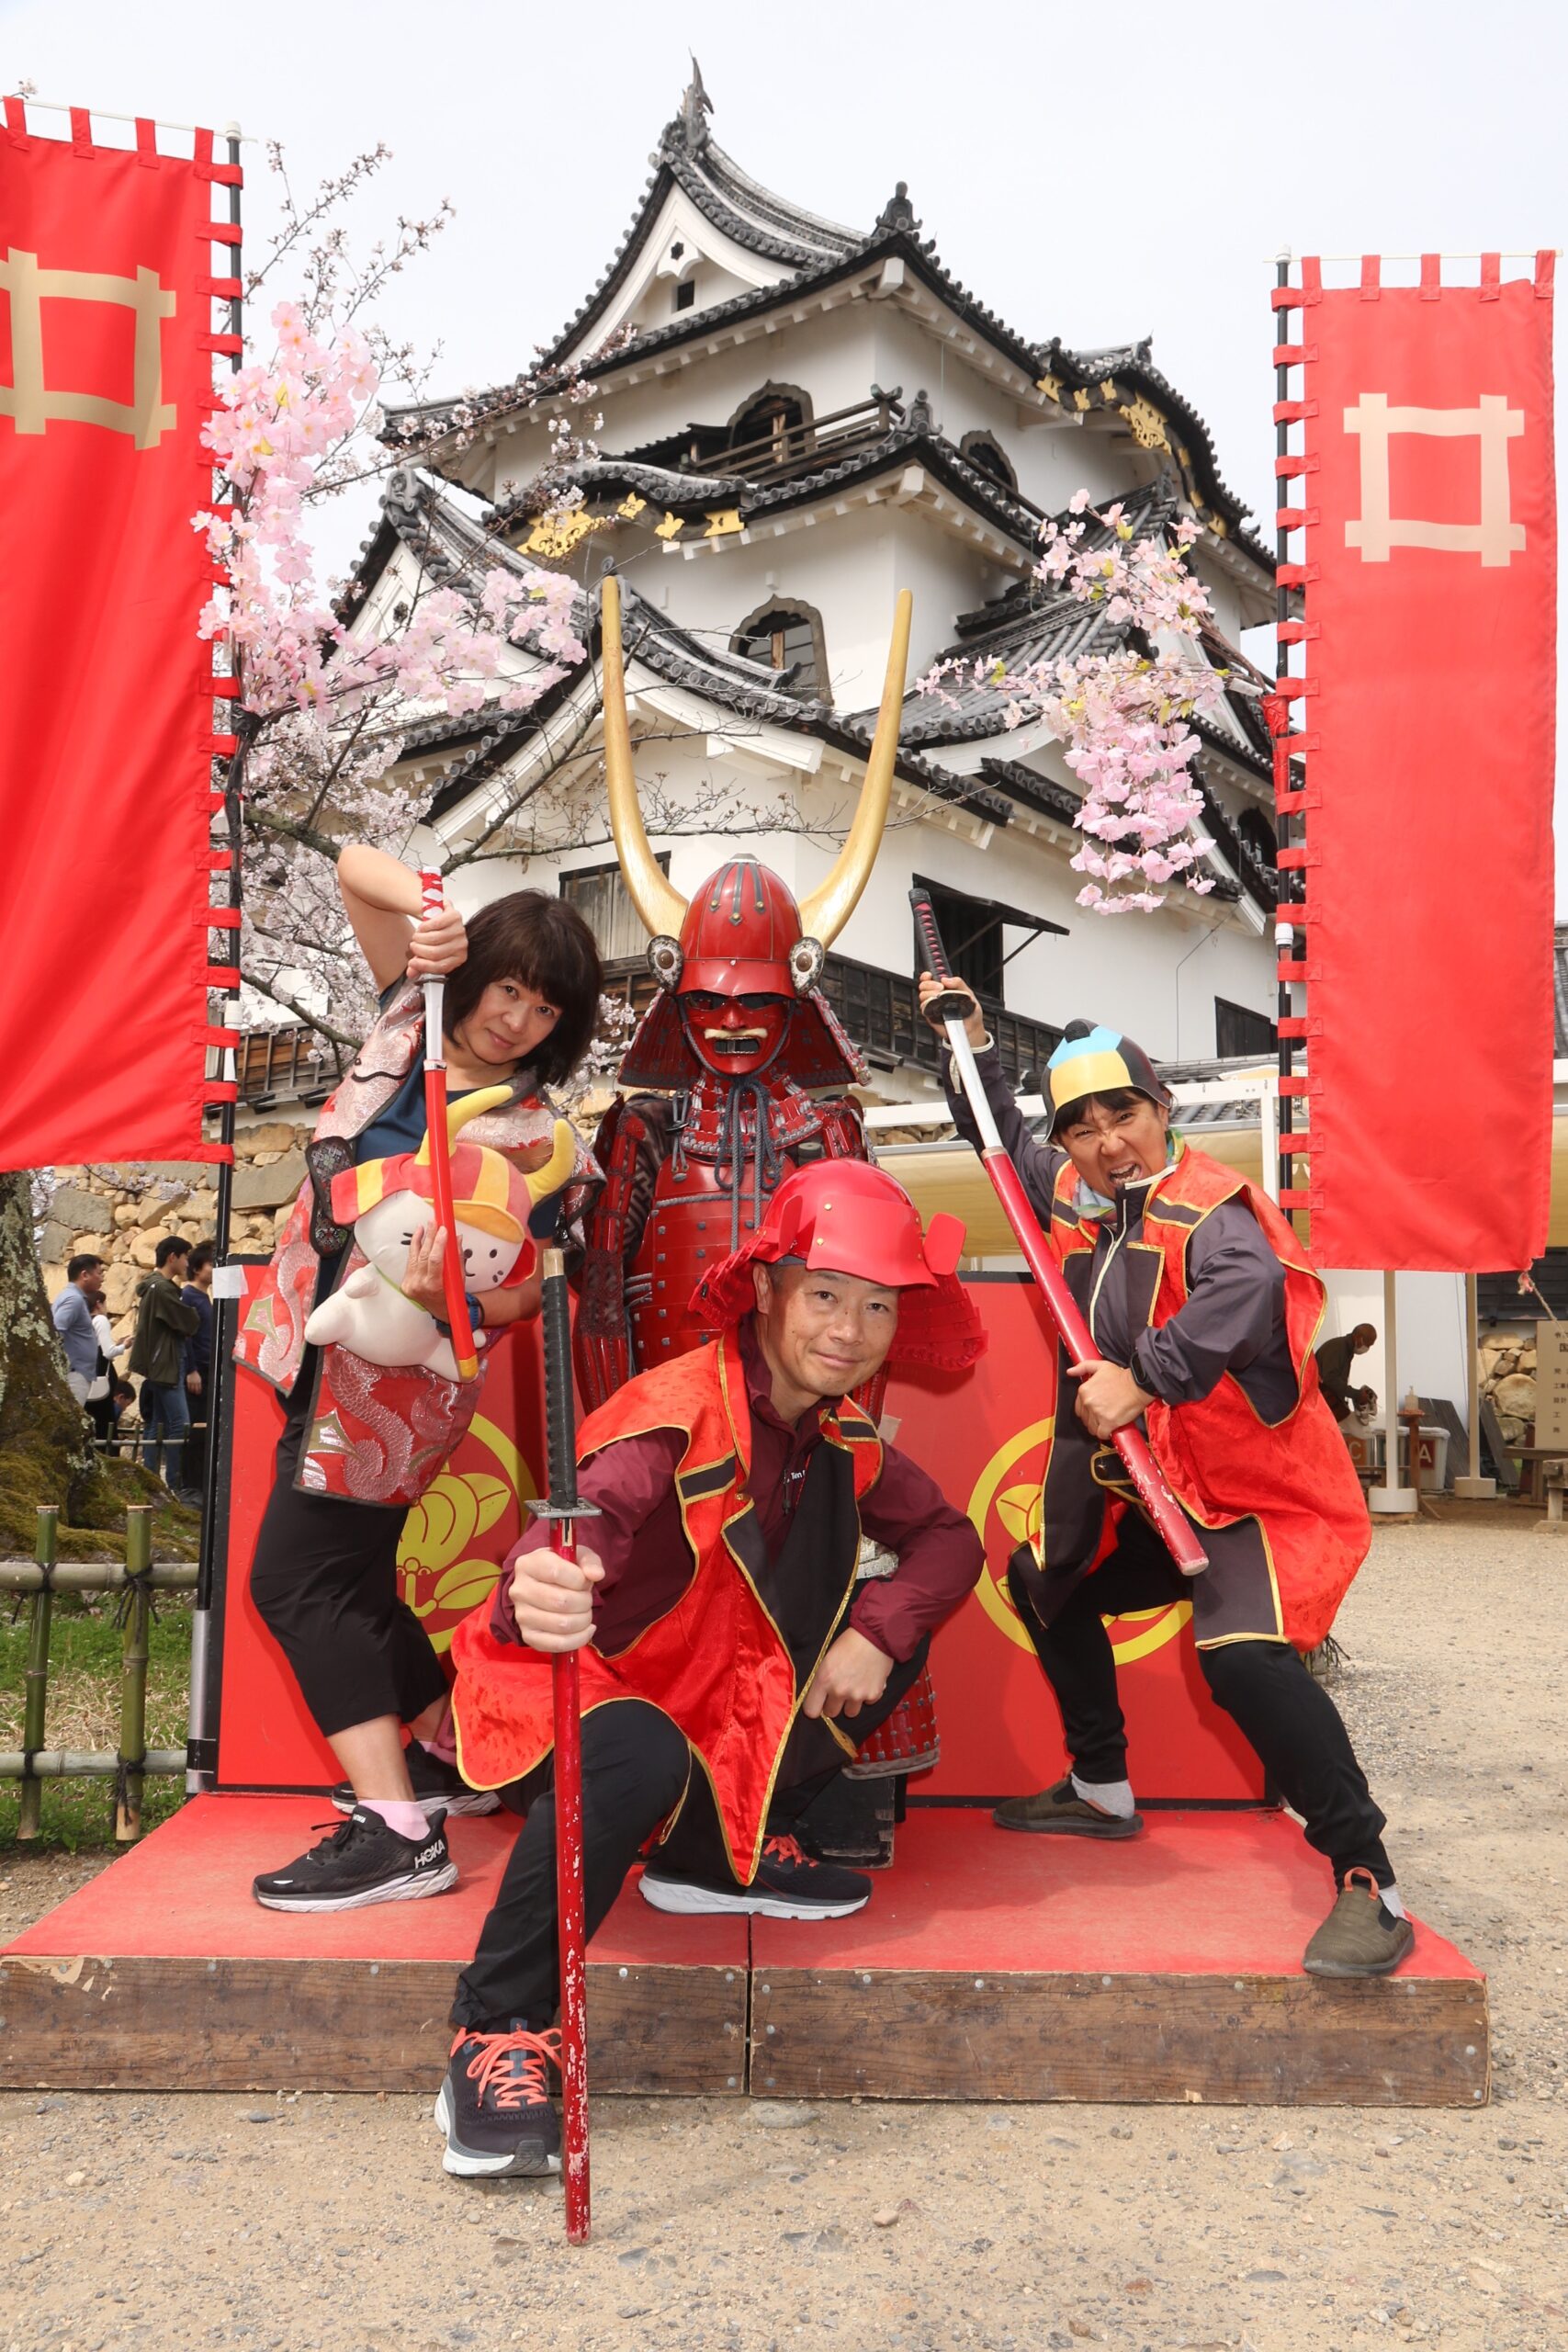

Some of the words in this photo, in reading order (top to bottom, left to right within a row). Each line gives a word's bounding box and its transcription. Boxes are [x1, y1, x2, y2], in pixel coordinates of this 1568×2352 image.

[1348, 1441, 1362, 1460] C
[1418, 1443, 1433, 1464] A
[414, 1839, 446, 1869] HOKA
